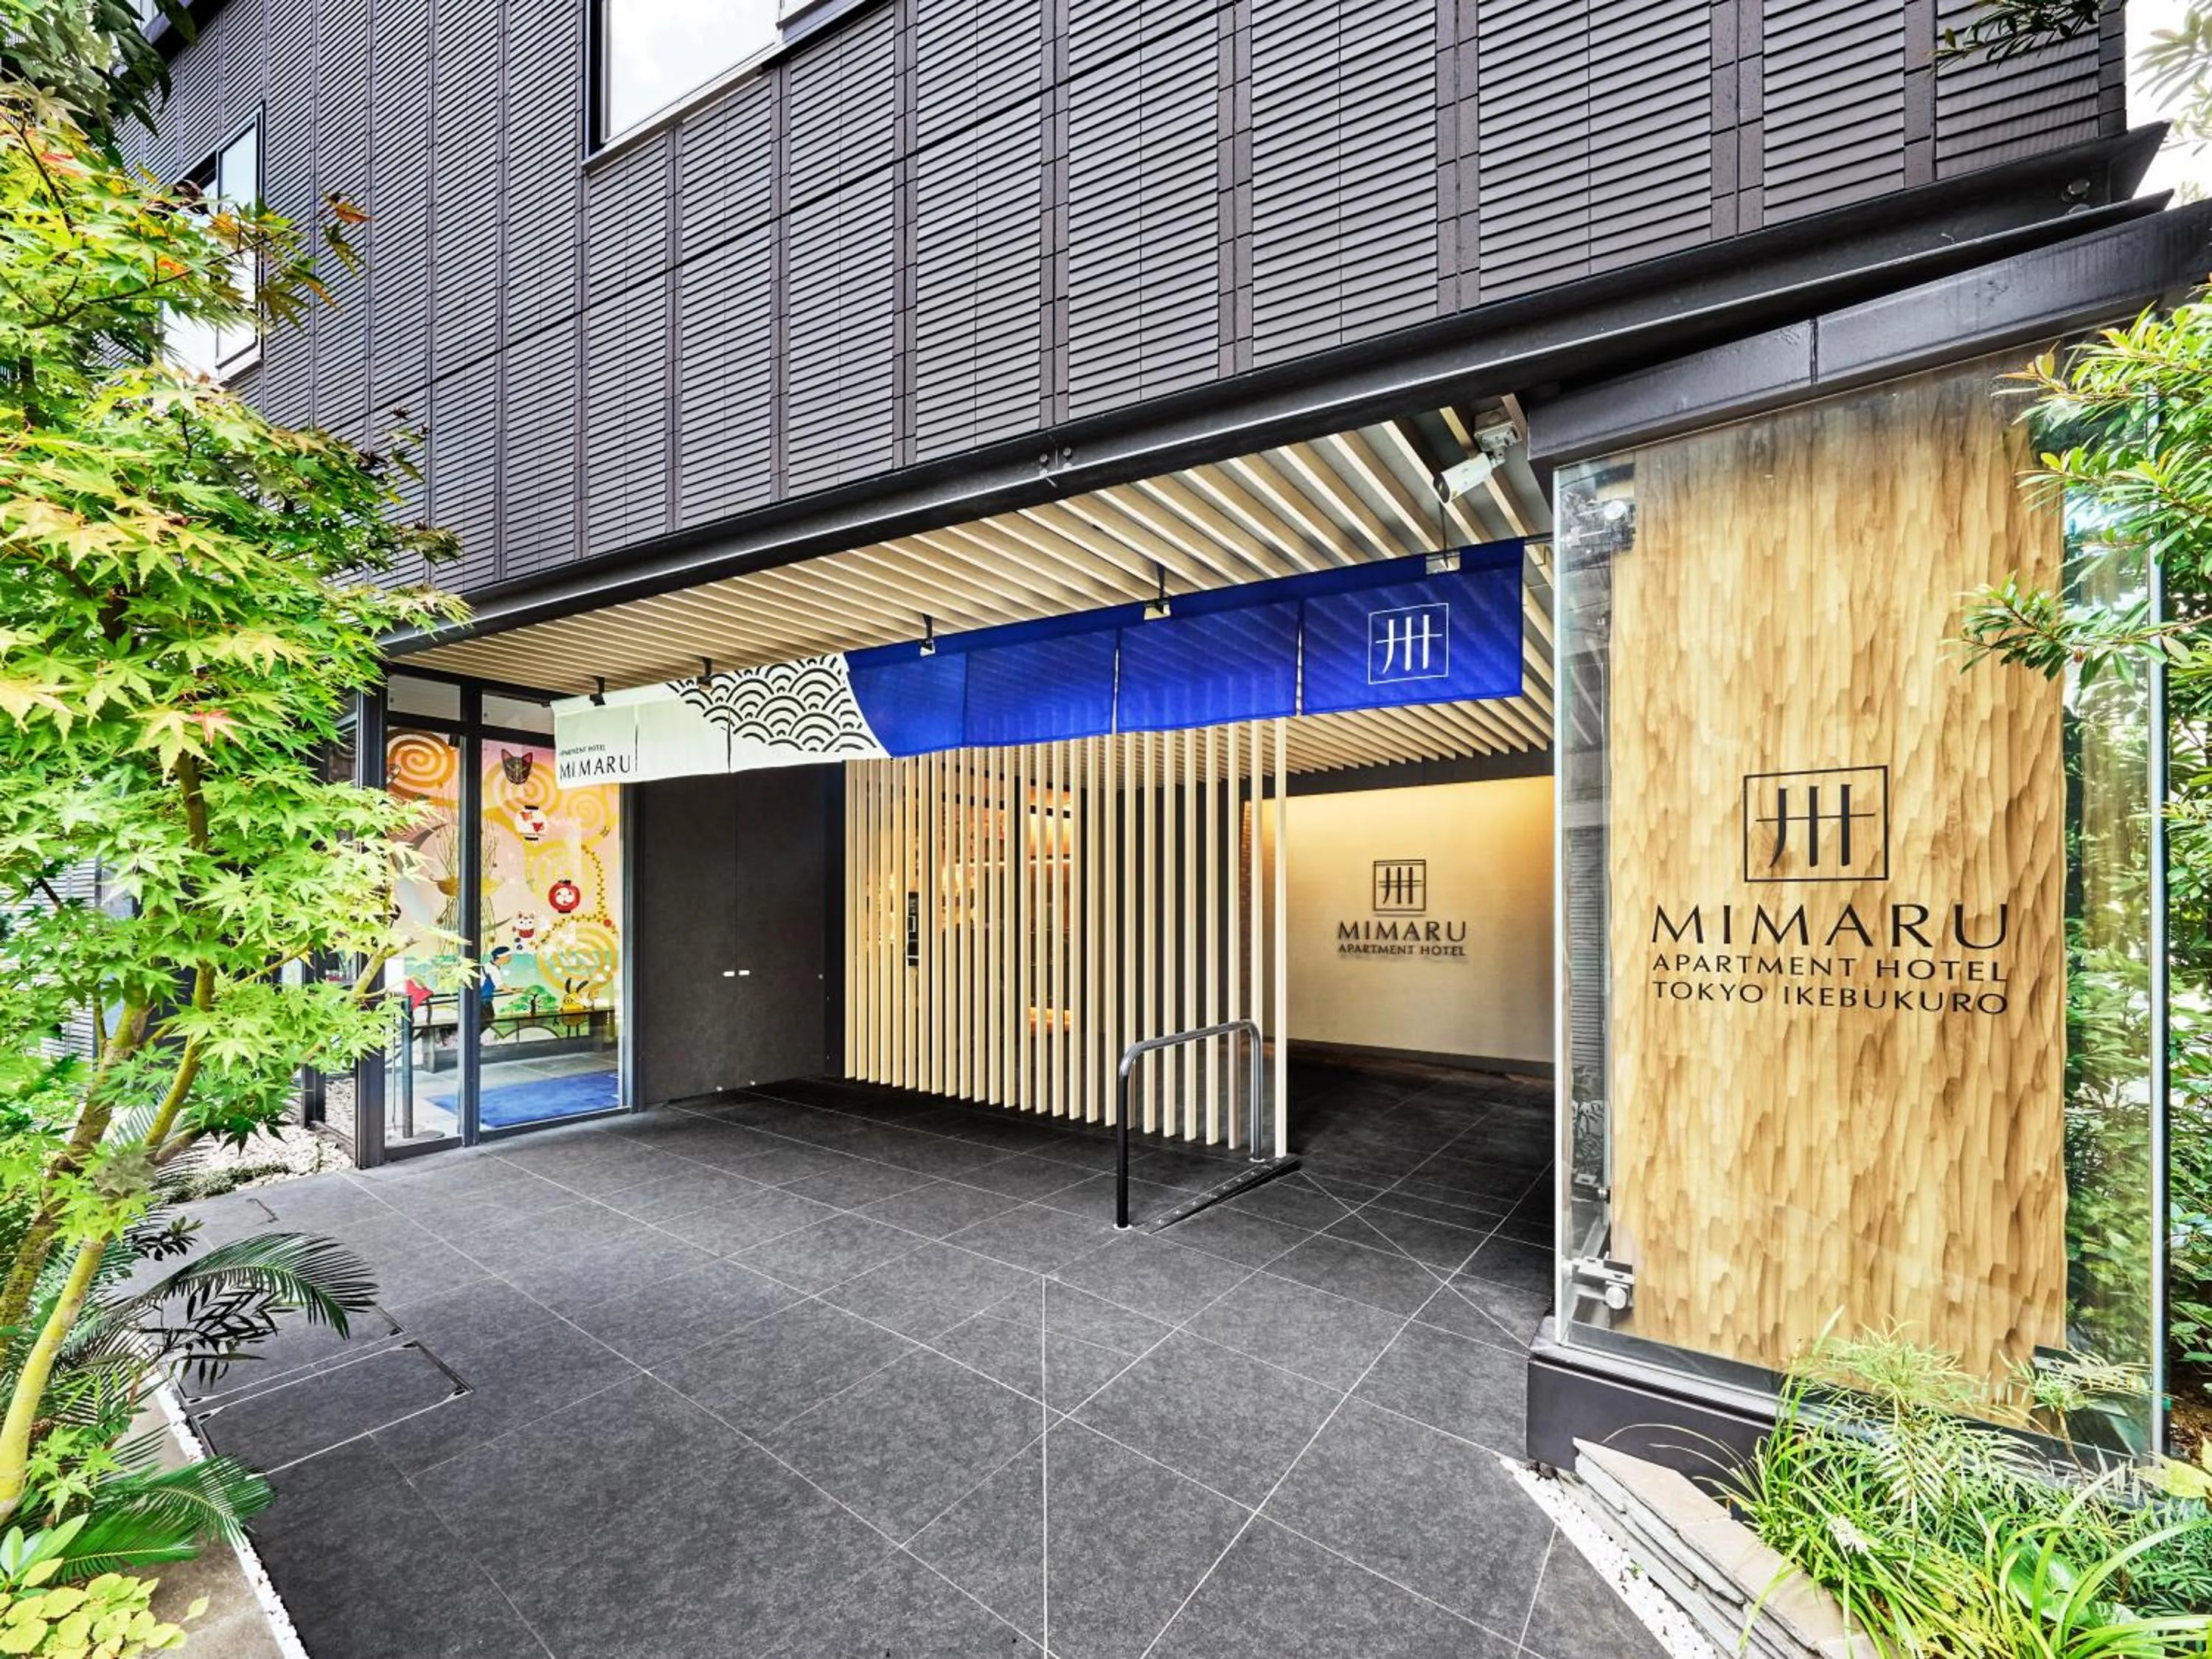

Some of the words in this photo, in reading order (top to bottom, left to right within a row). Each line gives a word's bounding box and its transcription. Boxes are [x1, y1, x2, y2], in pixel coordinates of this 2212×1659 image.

[560, 754, 630, 779] MIMARU
[1338, 920, 1467, 942] MIMARU
[1651, 903, 2009, 950] MIMARU
[1338, 943, 1416, 956] APARTMENT
[1420, 945, 1467, 957] HOTEL
[1652, 953, 1857, 978] APARTMENT
[1876, 959, 2010, 983] HOTEL
[1652, 981, 1764, 1004] TOKYO
[1784, 985, 2009, 1016] IKEBUKURO
